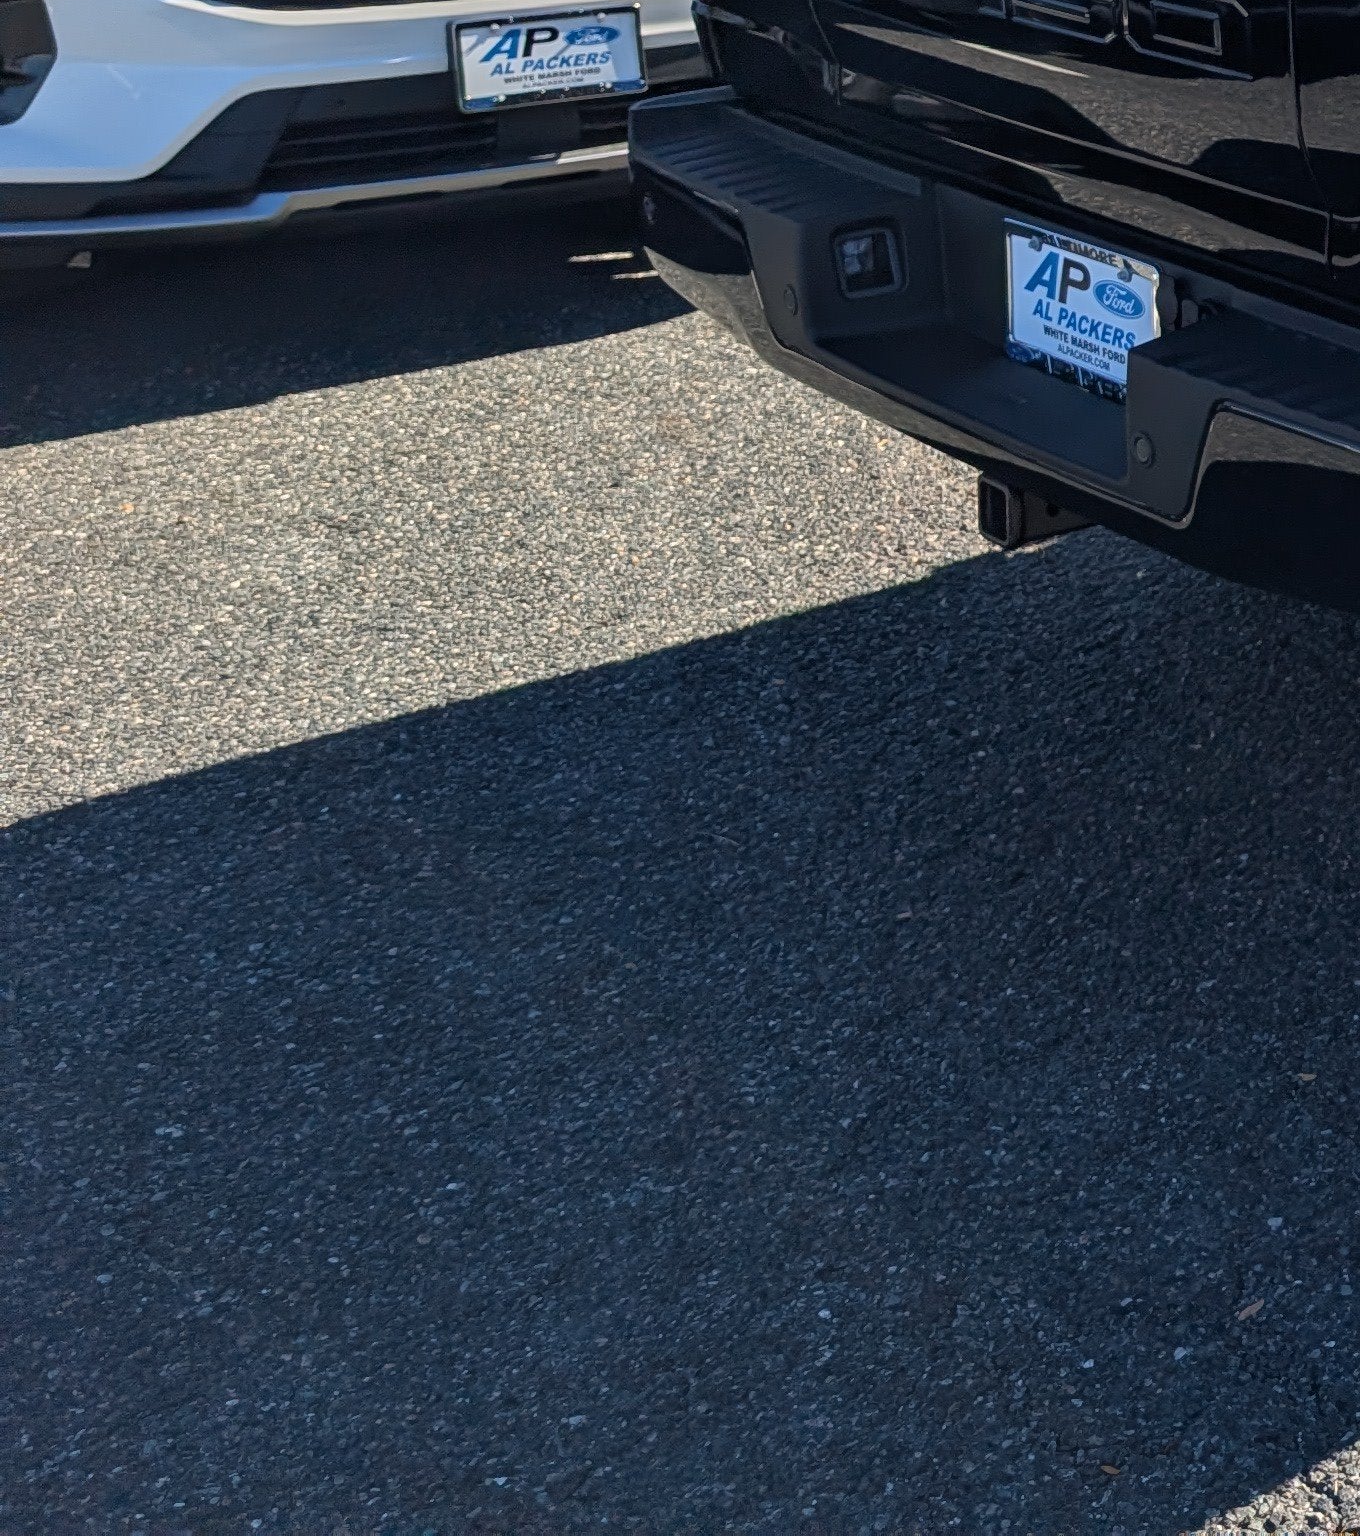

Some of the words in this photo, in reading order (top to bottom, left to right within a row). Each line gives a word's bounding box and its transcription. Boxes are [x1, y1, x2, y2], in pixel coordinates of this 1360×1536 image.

[479, 26, 560, 64] AP
[490, 63, 515, 77] AL
[521, 50, 613, 73] PACKERS
[503, 73, 535, 85] WHITE
[1024, 250, 1091, 304] AP
[1102, 284, 1136, 315] Ford
[1032, 298, 1053, 322] AL
[1057, 307, 1137, 351] PACKERS
[1043, 324, 1069, 344] WHITE
[1071, 336, 1101, 357] MARSH
[1102, 347, 1126, 365] FORD
